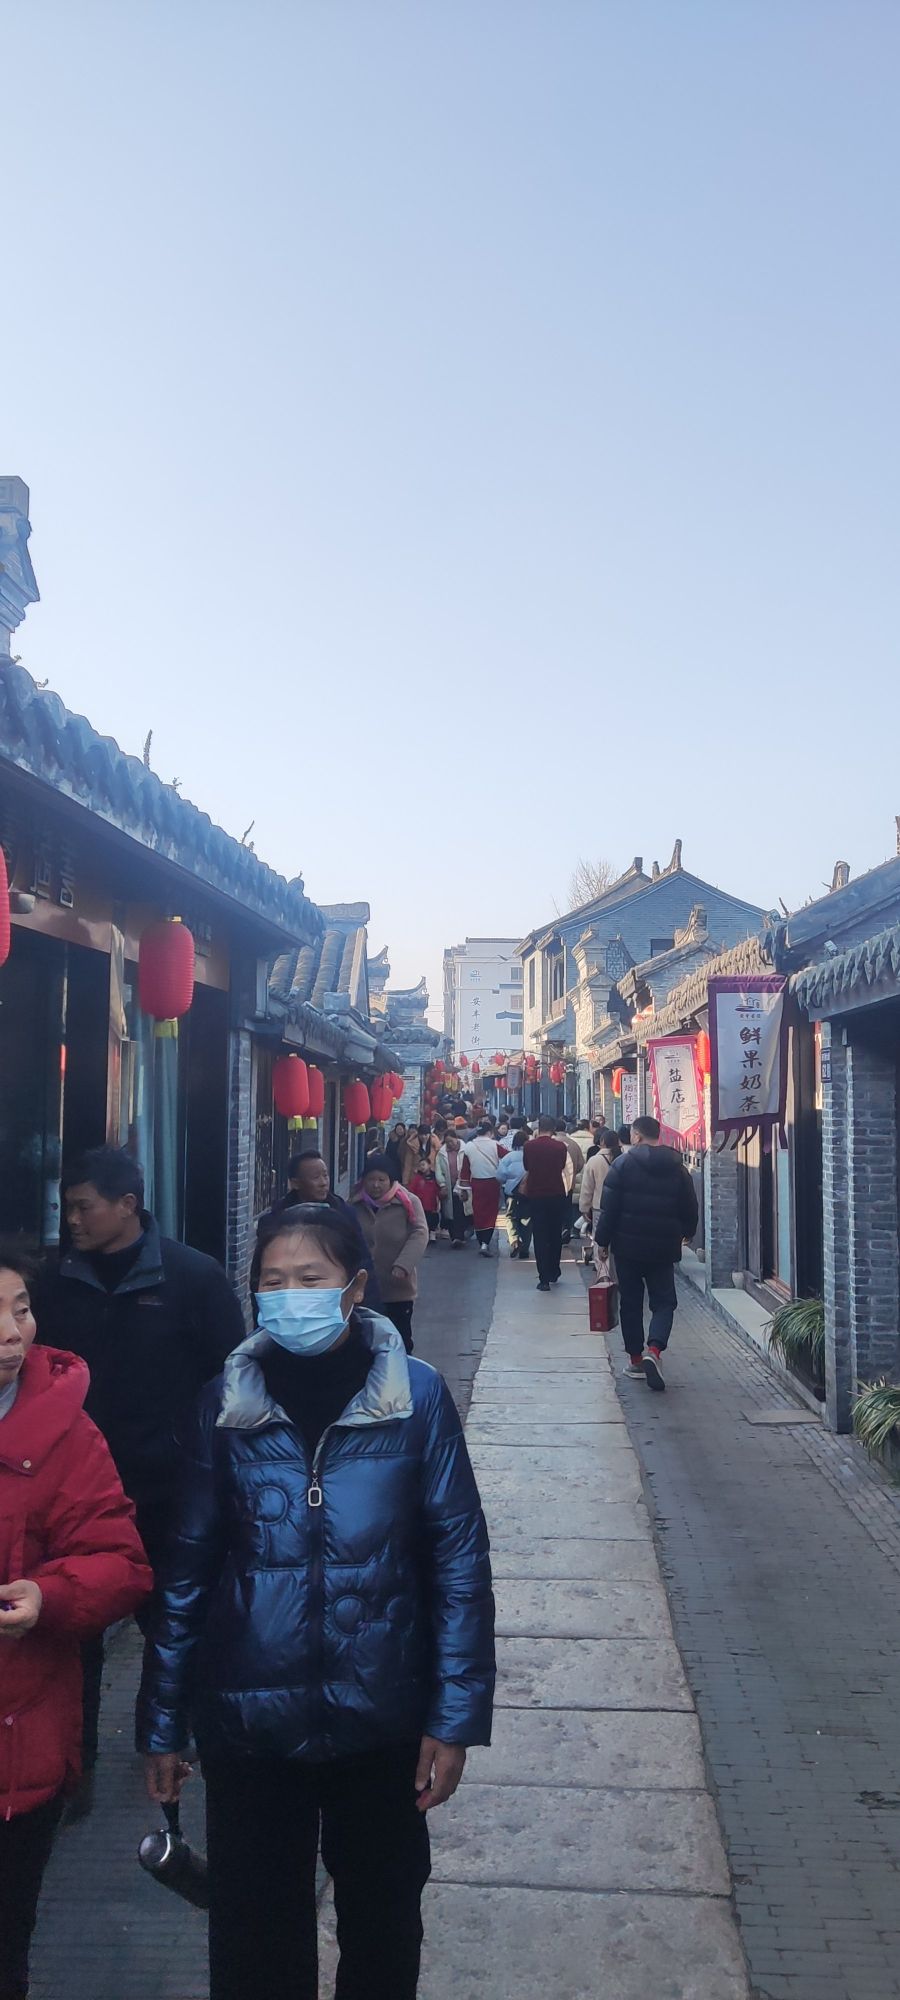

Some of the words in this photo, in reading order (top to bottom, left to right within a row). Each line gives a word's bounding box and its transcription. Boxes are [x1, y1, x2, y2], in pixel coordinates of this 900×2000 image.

[668, 1067, 685, 1103] 盐店
[739, 1026, 762, 1112] 鲜果奶茶
